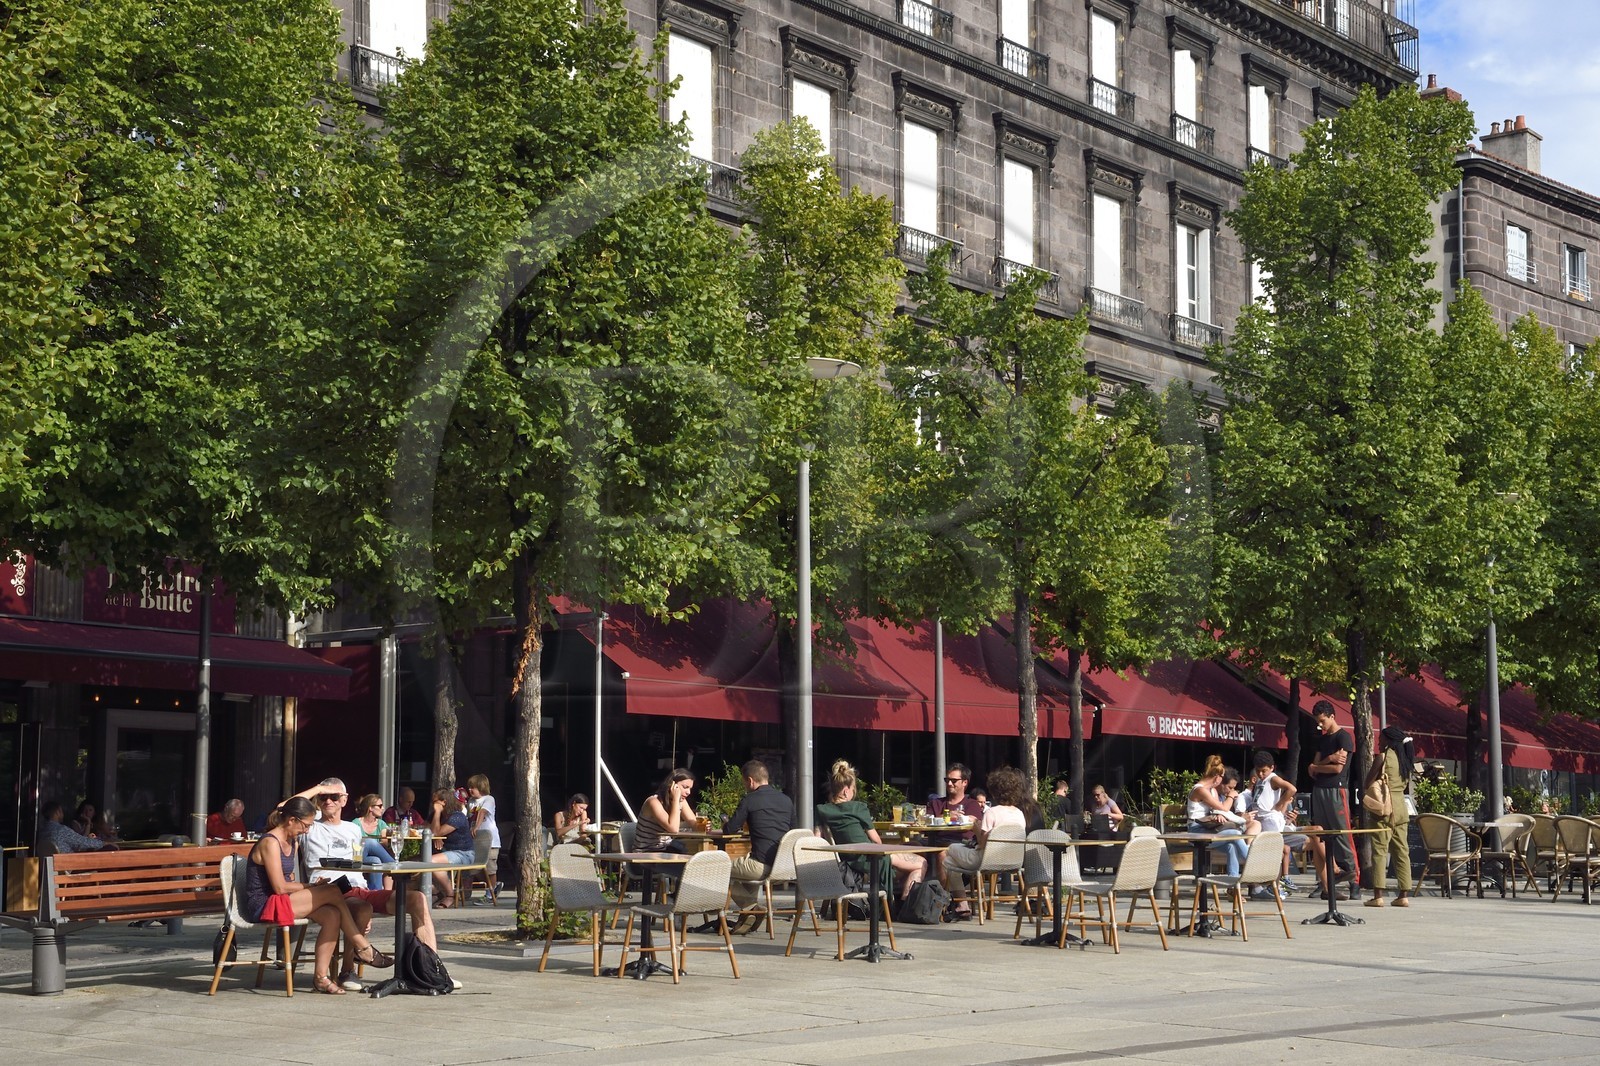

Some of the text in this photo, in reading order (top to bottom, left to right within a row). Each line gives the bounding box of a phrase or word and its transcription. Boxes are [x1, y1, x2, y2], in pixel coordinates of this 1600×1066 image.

[140, 586, 193, 613] Butte
[1159, 716, 1255, 742] BRASSERIE MADELEINE
